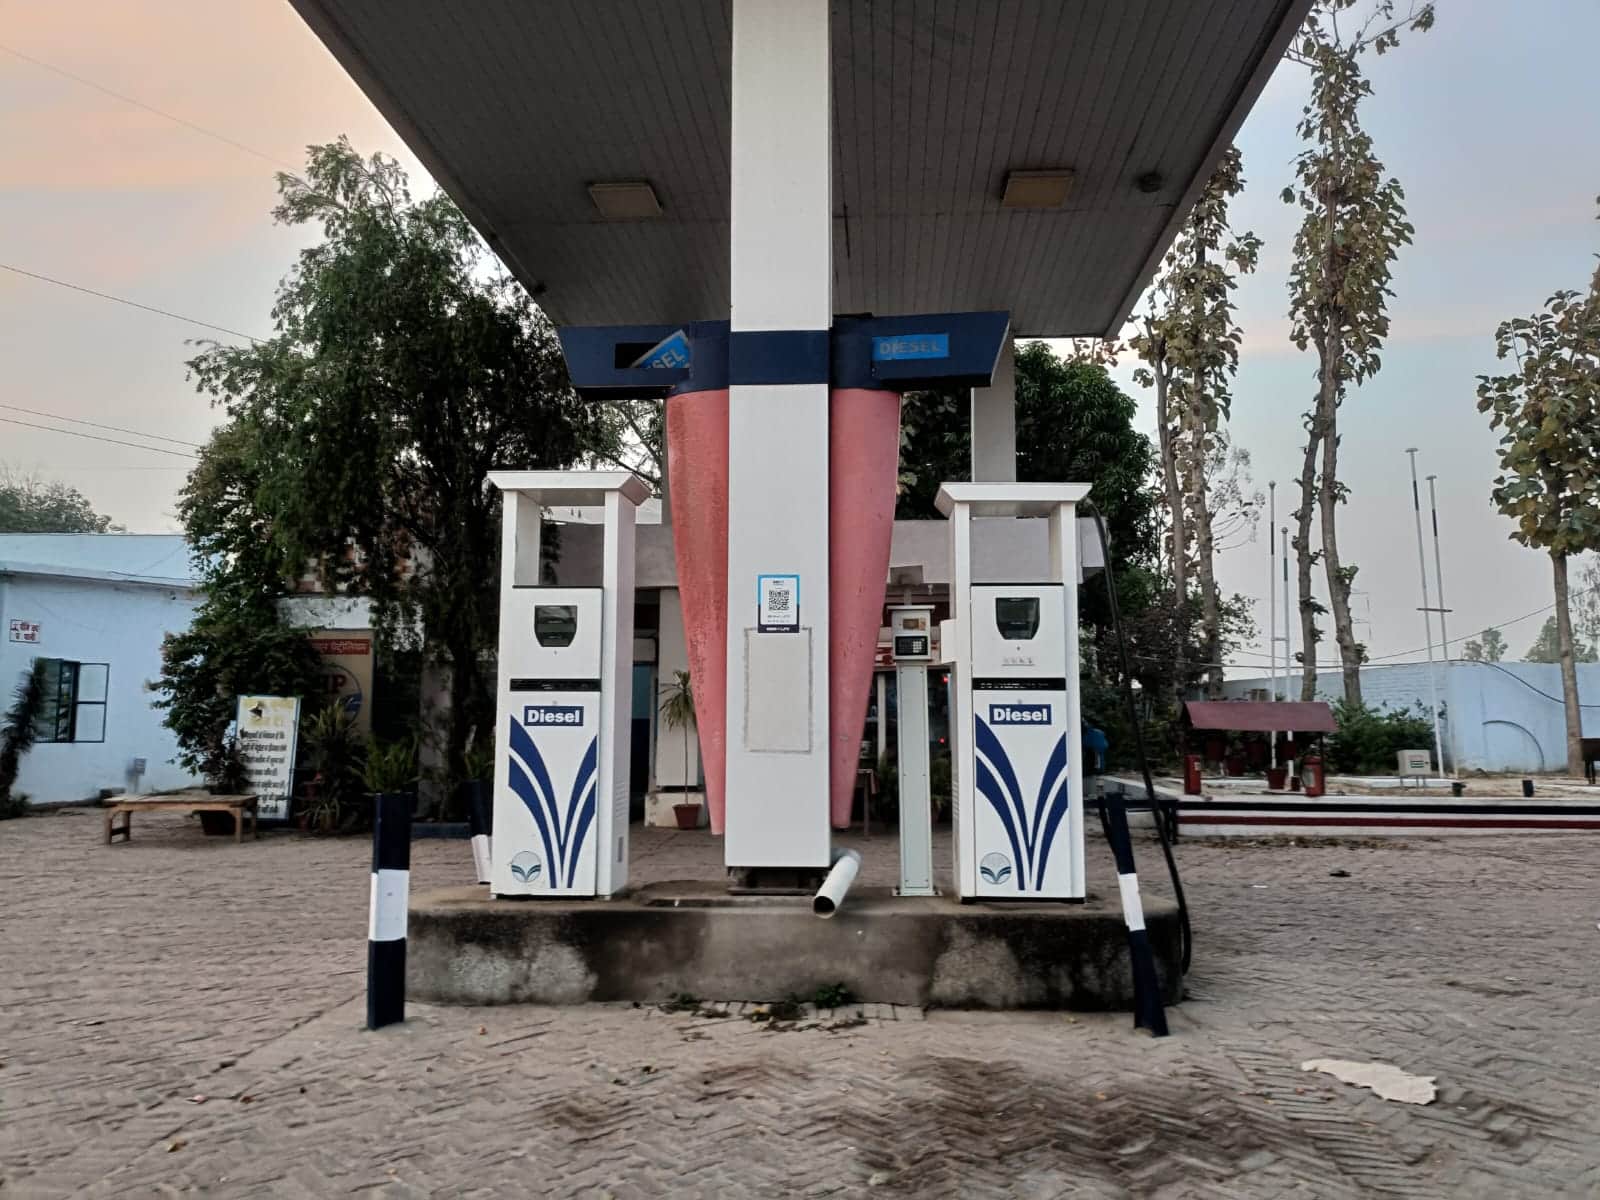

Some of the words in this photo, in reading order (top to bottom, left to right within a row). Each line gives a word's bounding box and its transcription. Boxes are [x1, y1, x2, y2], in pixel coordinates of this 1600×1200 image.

[648, 349, 686, 368] SEL
[527, 709, 580, 723] Diesel
[993, 708, 1048, 722] Diesel
